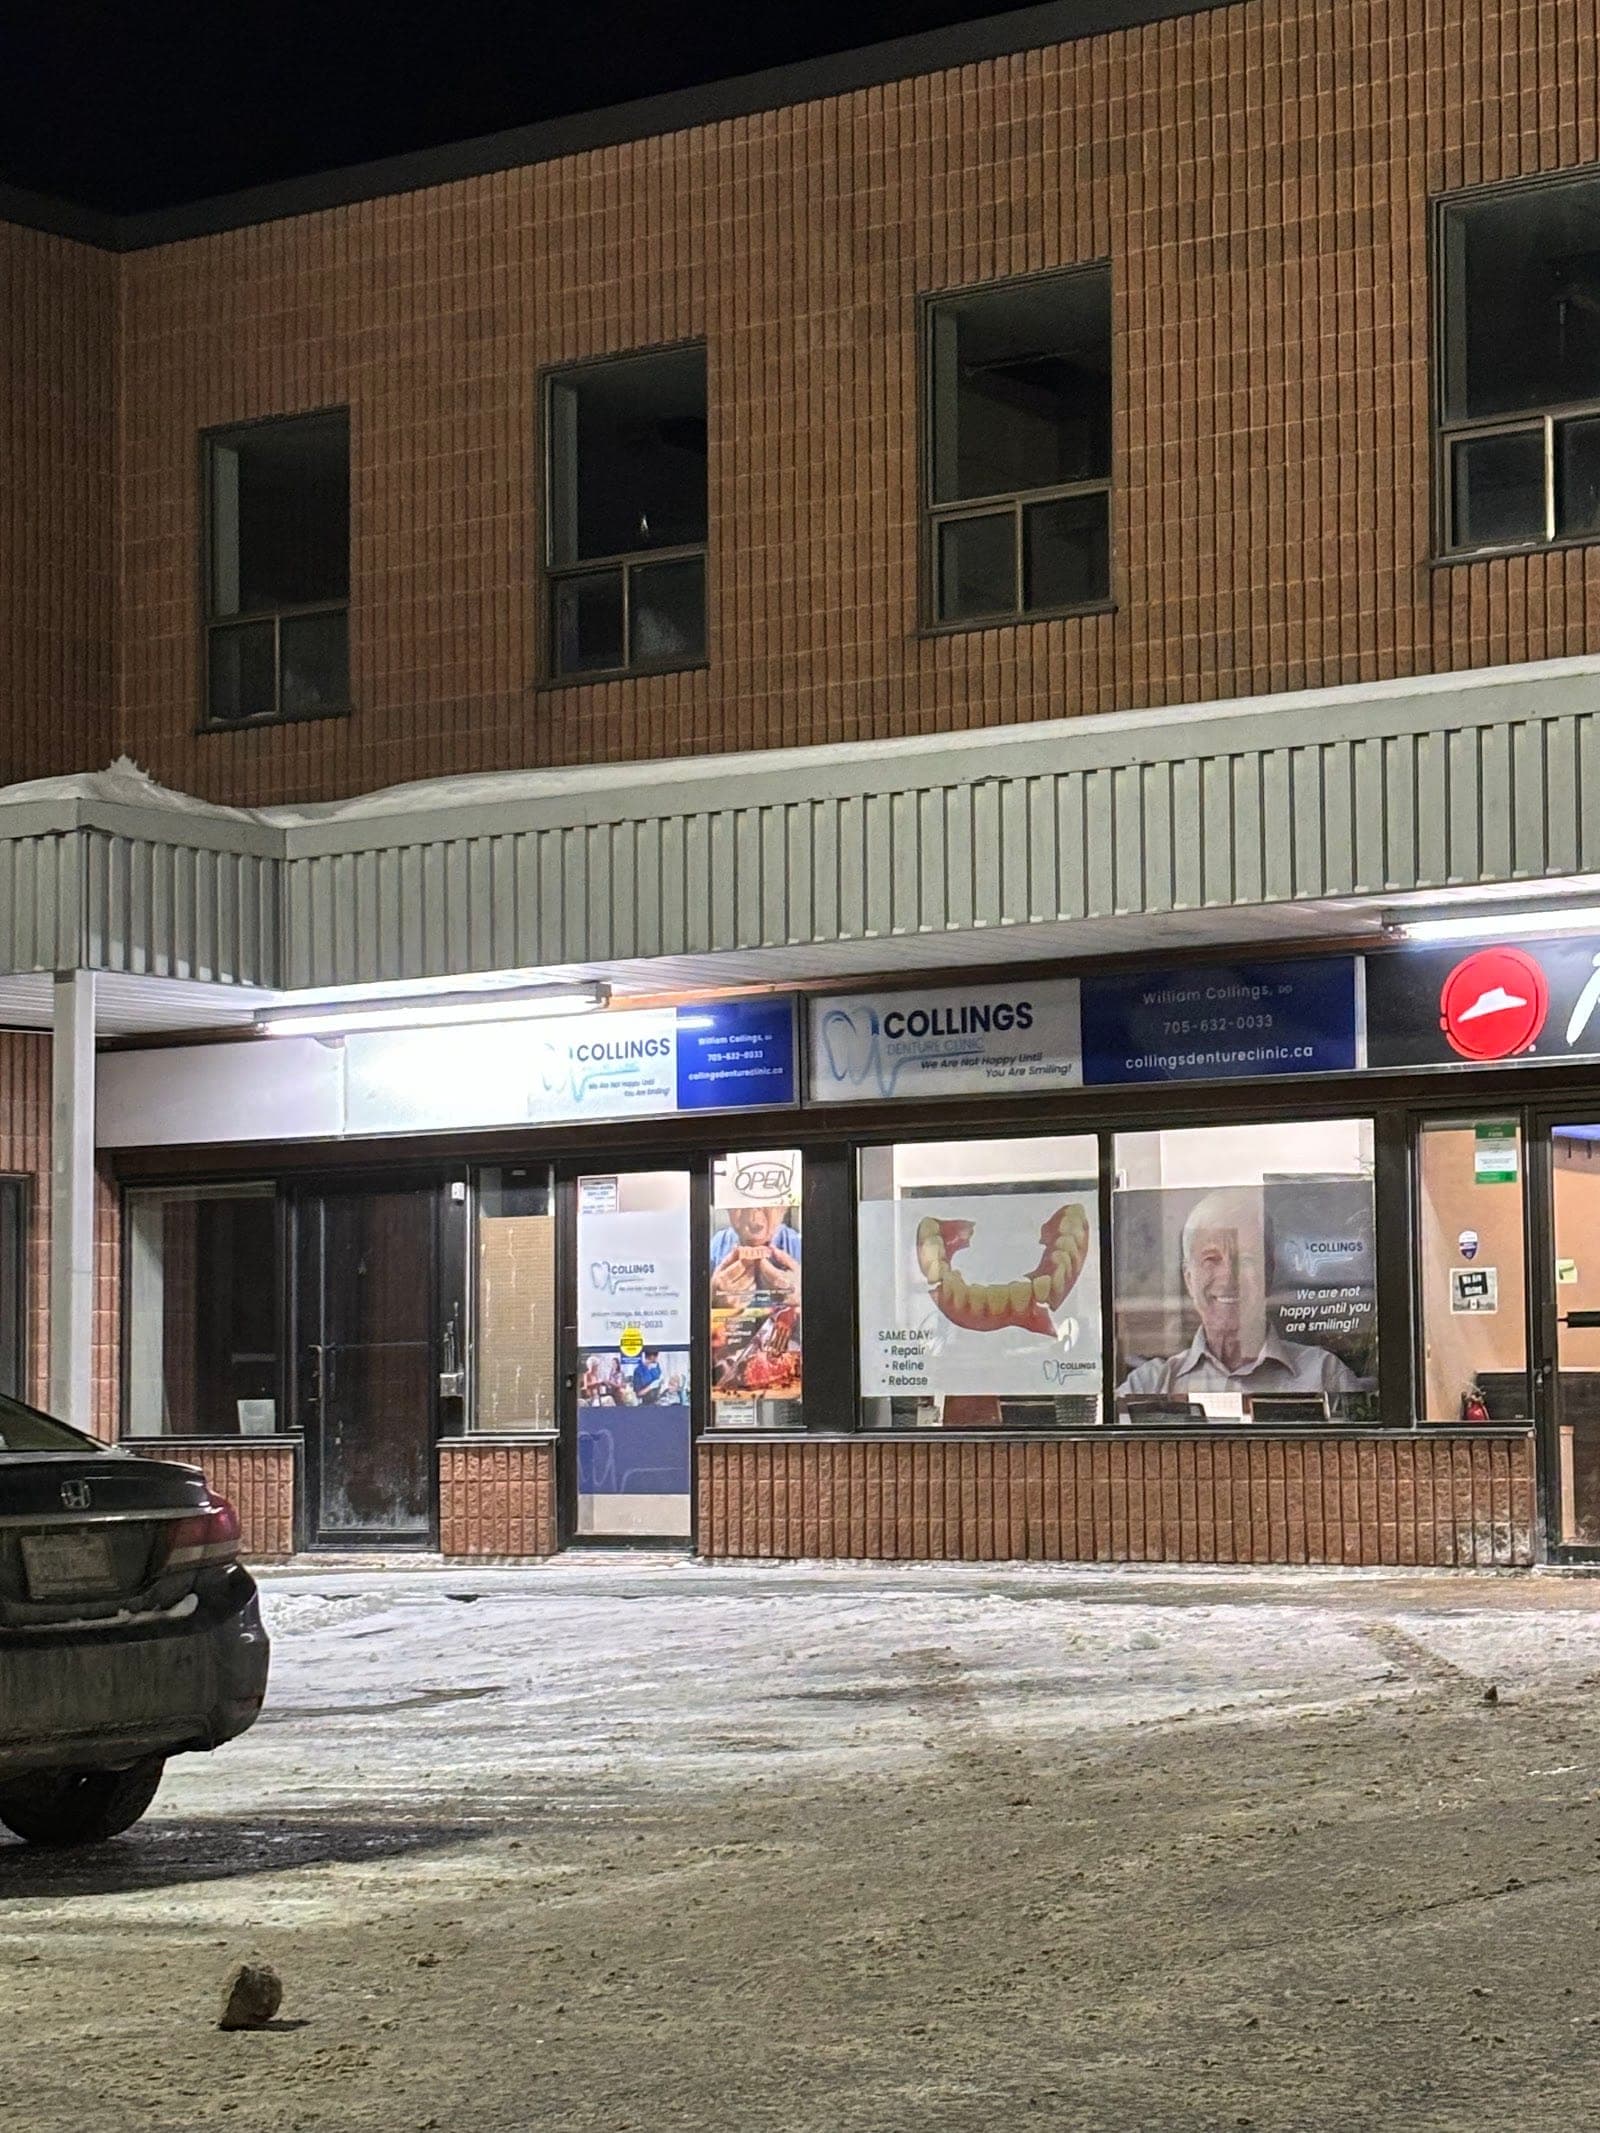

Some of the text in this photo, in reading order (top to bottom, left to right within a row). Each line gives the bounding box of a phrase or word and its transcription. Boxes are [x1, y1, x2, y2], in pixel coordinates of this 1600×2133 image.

[1143, 991, 1201, 1005] William
[1206, 984, 1273, 1000] Collings,
[883, 1001, 1034, 1039] COLLINGS
[1163, 1014, 1273, 1035] 705-632-0033
[576, 1038, 670, 1061] COLLINGS
[887, 1037, 985, 1055] DENTURE CLINIC
[921, 1052, 1043, 1070] We Are Not Happy Until
[1125, 1045, 1314, 1070] collingsdentureclinic.ca
[986, 1063, 1072, 1078] You Are Smiling!
[735, 1170, 793, 1191] OPEN
[1310, 1241, 1363, 1253] COLLINGS
[611, 1264, 655, 1275] COLLINGS
[1296, 1285, 1361, 1300] We are not
[1280, 1302, 1372, 1319] happy until you
[1286, 1317, 1360, 1333] are smiling!!
[878, 1330, 907, 1341] SAME
[890, 1345, 926, 1358] Repair
[891, 1360, 925, 1371] Reline
[1060, 1362, 1096, 1370] COLLINGS
[888, 1375, 928, 1386] Rebase
